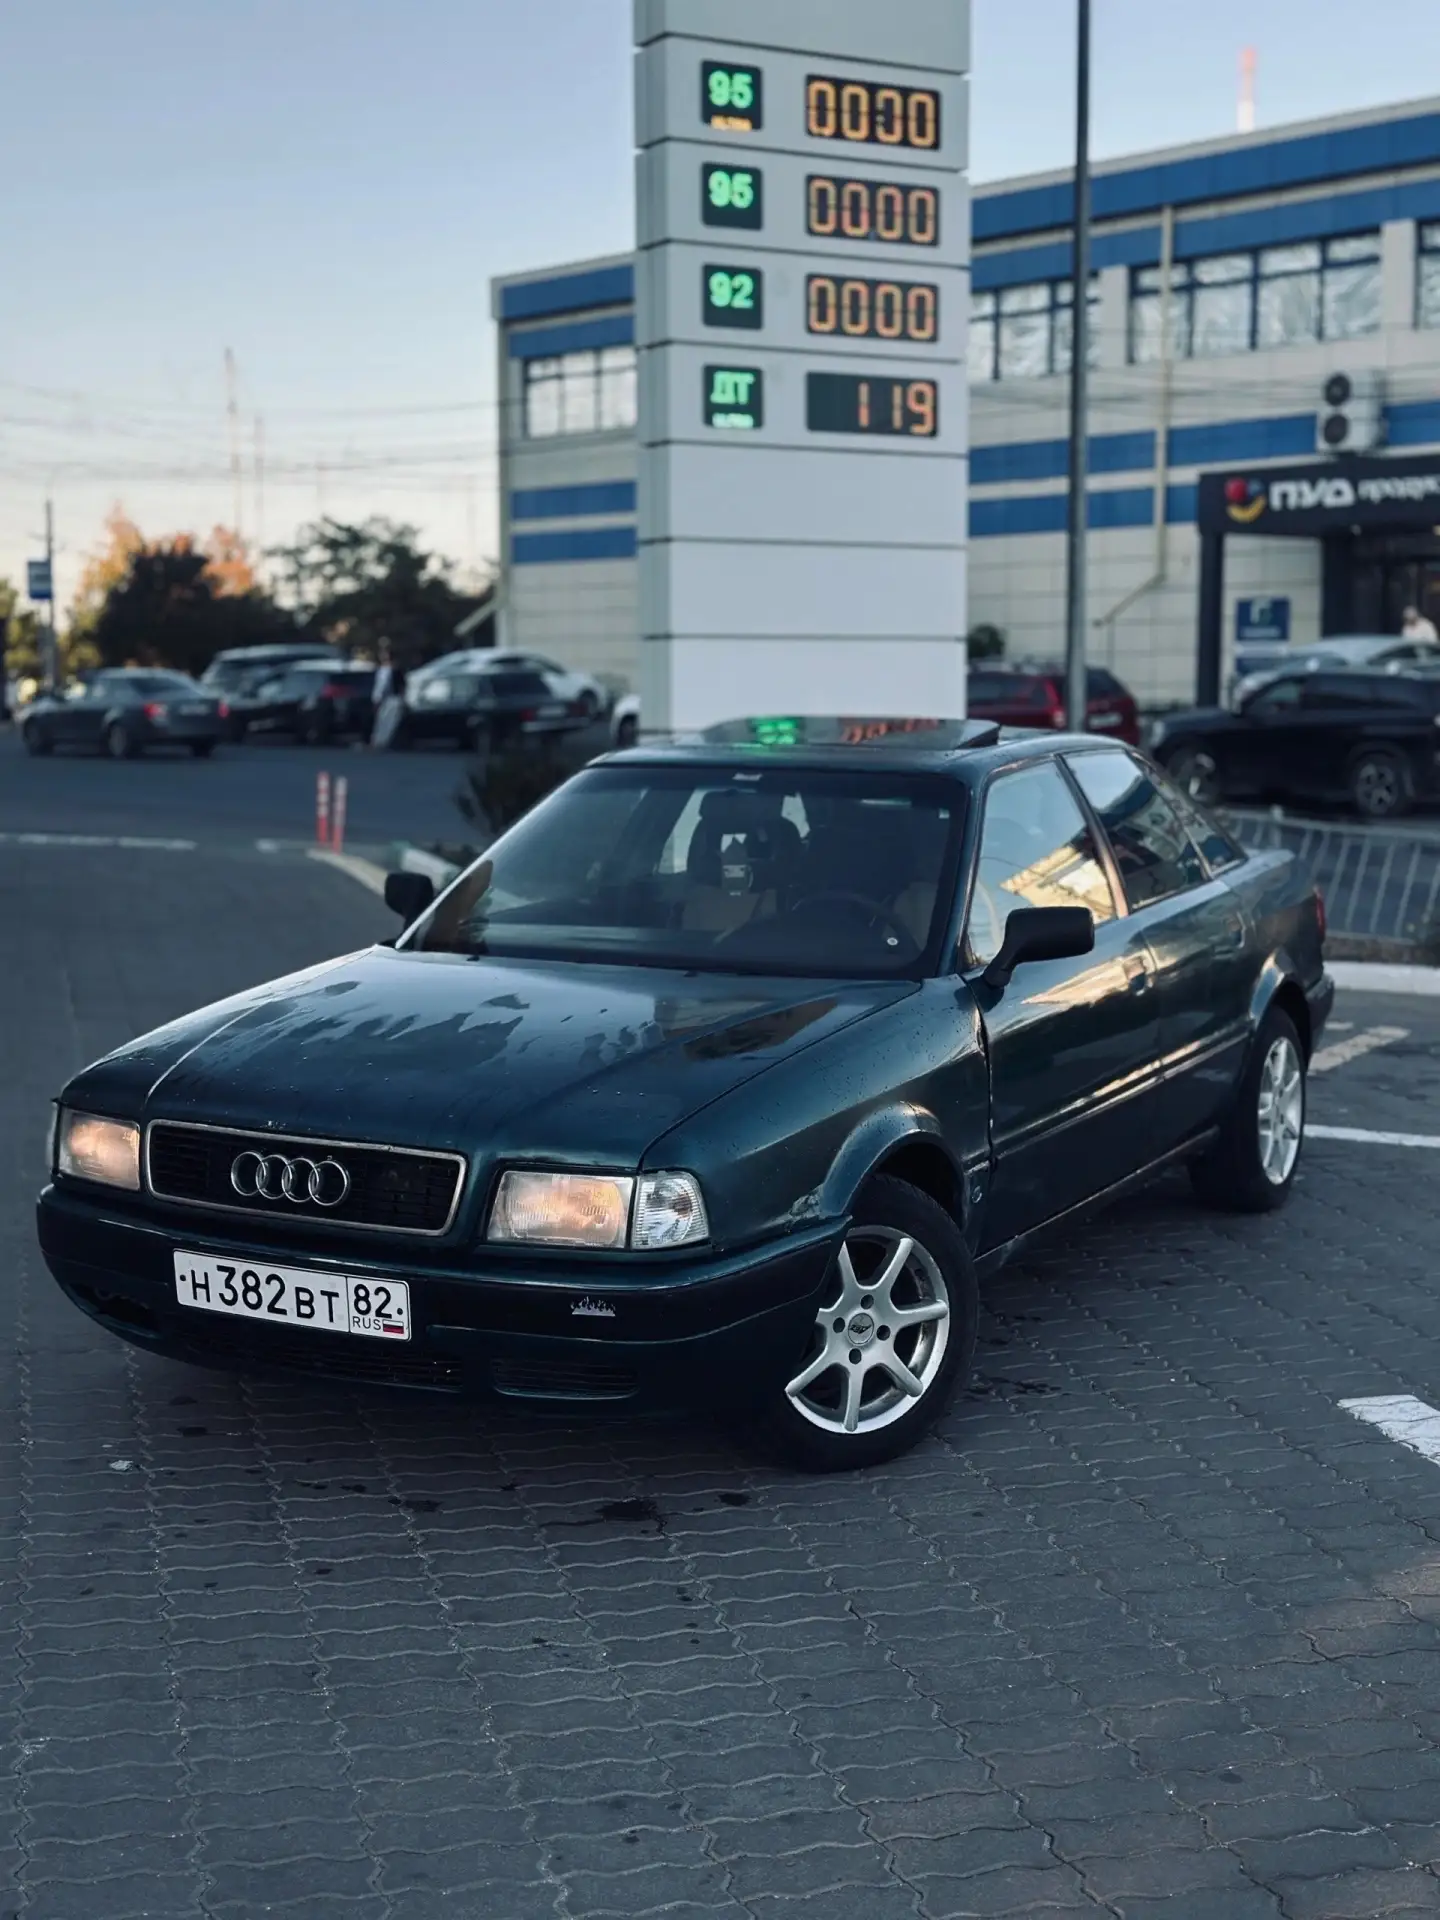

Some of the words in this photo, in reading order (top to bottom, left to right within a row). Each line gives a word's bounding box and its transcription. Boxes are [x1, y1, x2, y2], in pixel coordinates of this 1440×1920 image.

[708, 70, 754, 108] 95
[708, 171, 754, 208] 95
[808, 178, 936, 244] 0000
[708, 272, 754, 309] 92
[808, 278, 935, 340] 0000
[710, 370, 755, 405] ДТ
[858, 382, 935, 435] 119
[352, 1316, 382, 1331] RUS
[353, 1283, 393, 1319] 82
